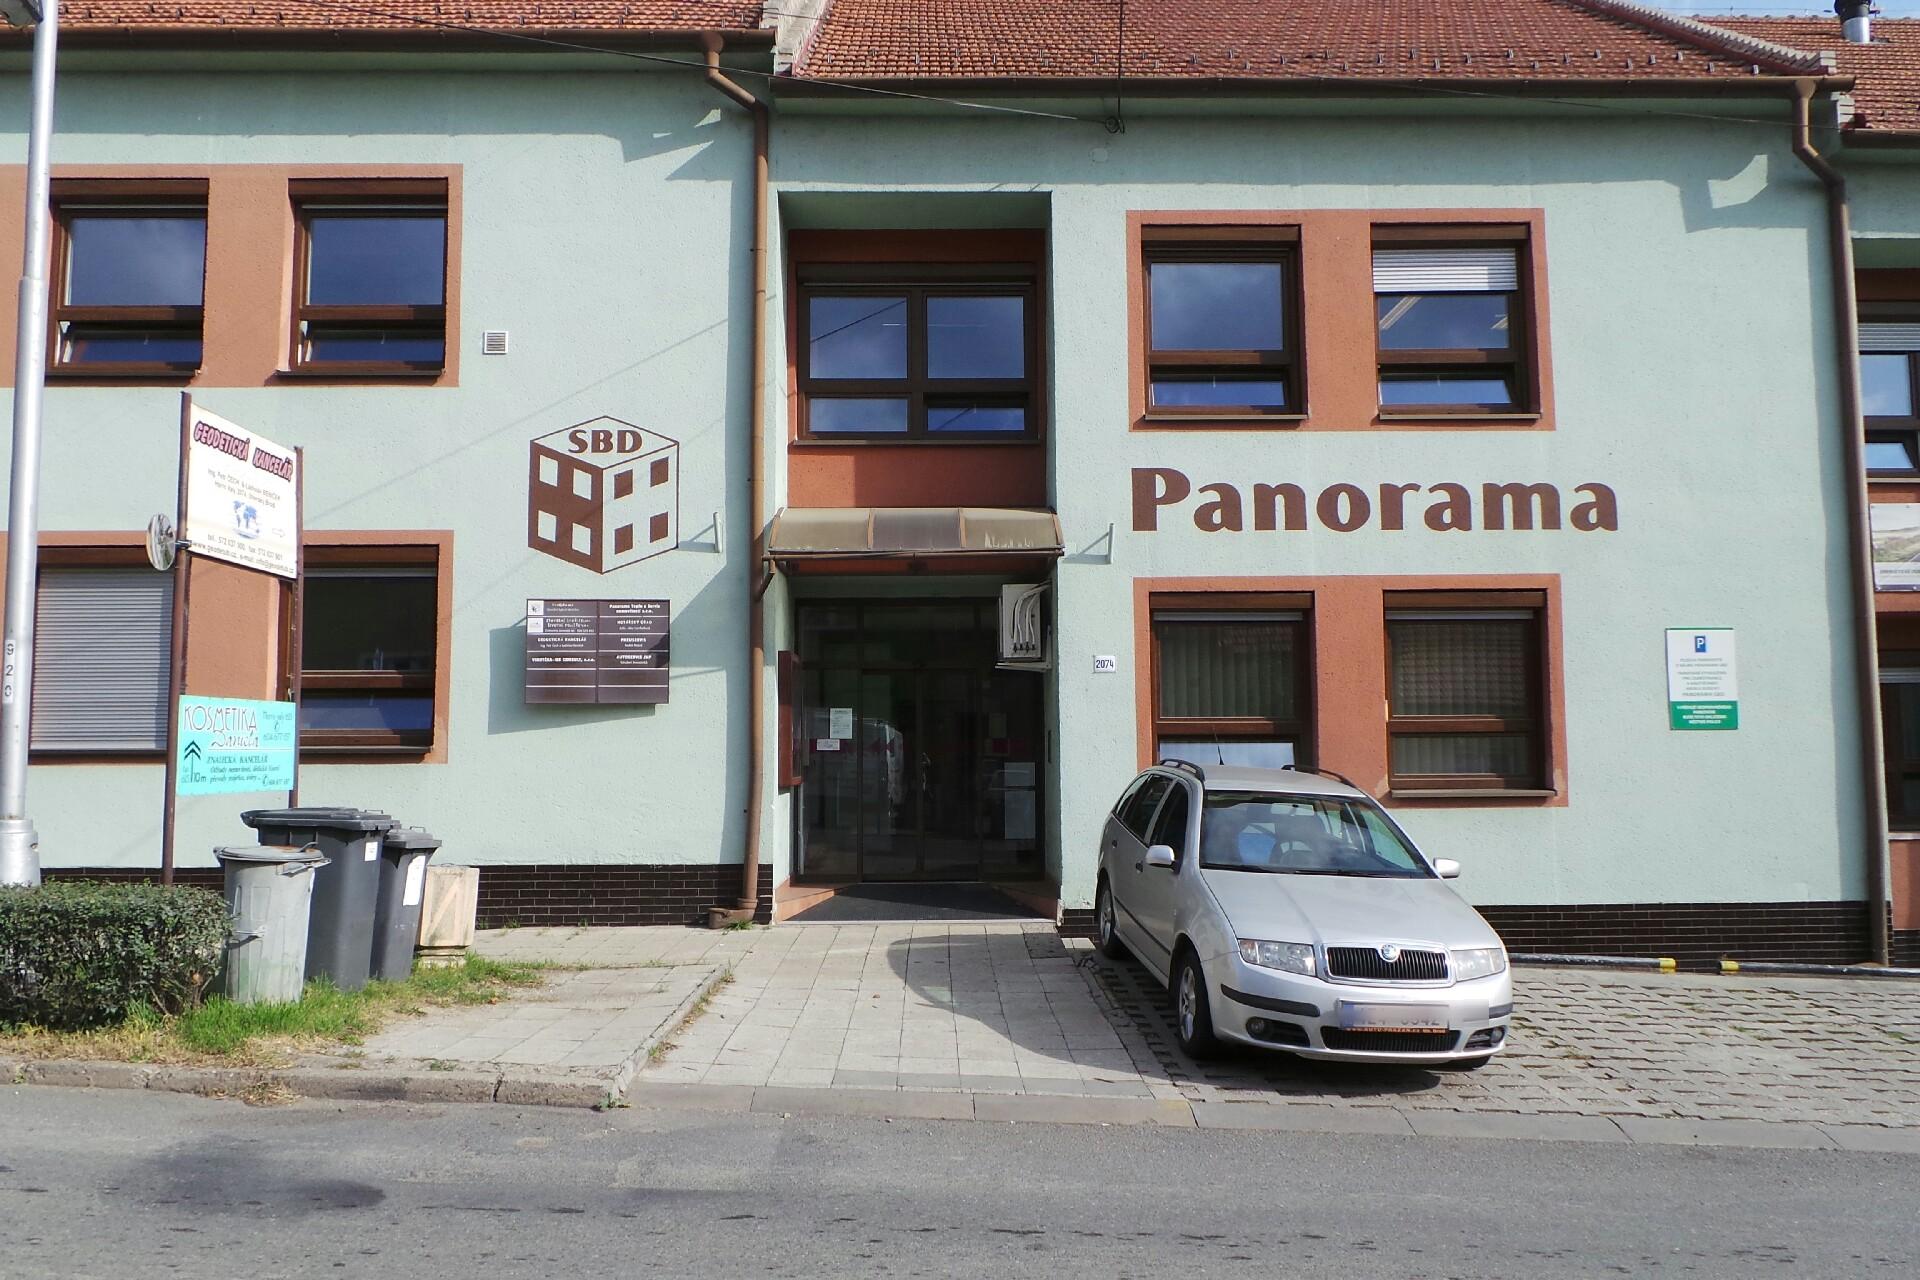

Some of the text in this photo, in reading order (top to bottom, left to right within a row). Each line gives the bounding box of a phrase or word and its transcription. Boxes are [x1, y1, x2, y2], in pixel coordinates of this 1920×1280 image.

[193, 420, 293, 482] GEODETICKÁ KANCELÁŘ
[567, 429, 643, 454] SBD
[1130, 467, 1619, 532] Panorama
[1696, 637, 1705, 649] P
[1096, 659, 1114, 669] 2074
[183, 705, 257, 731] KOSMETIKA
